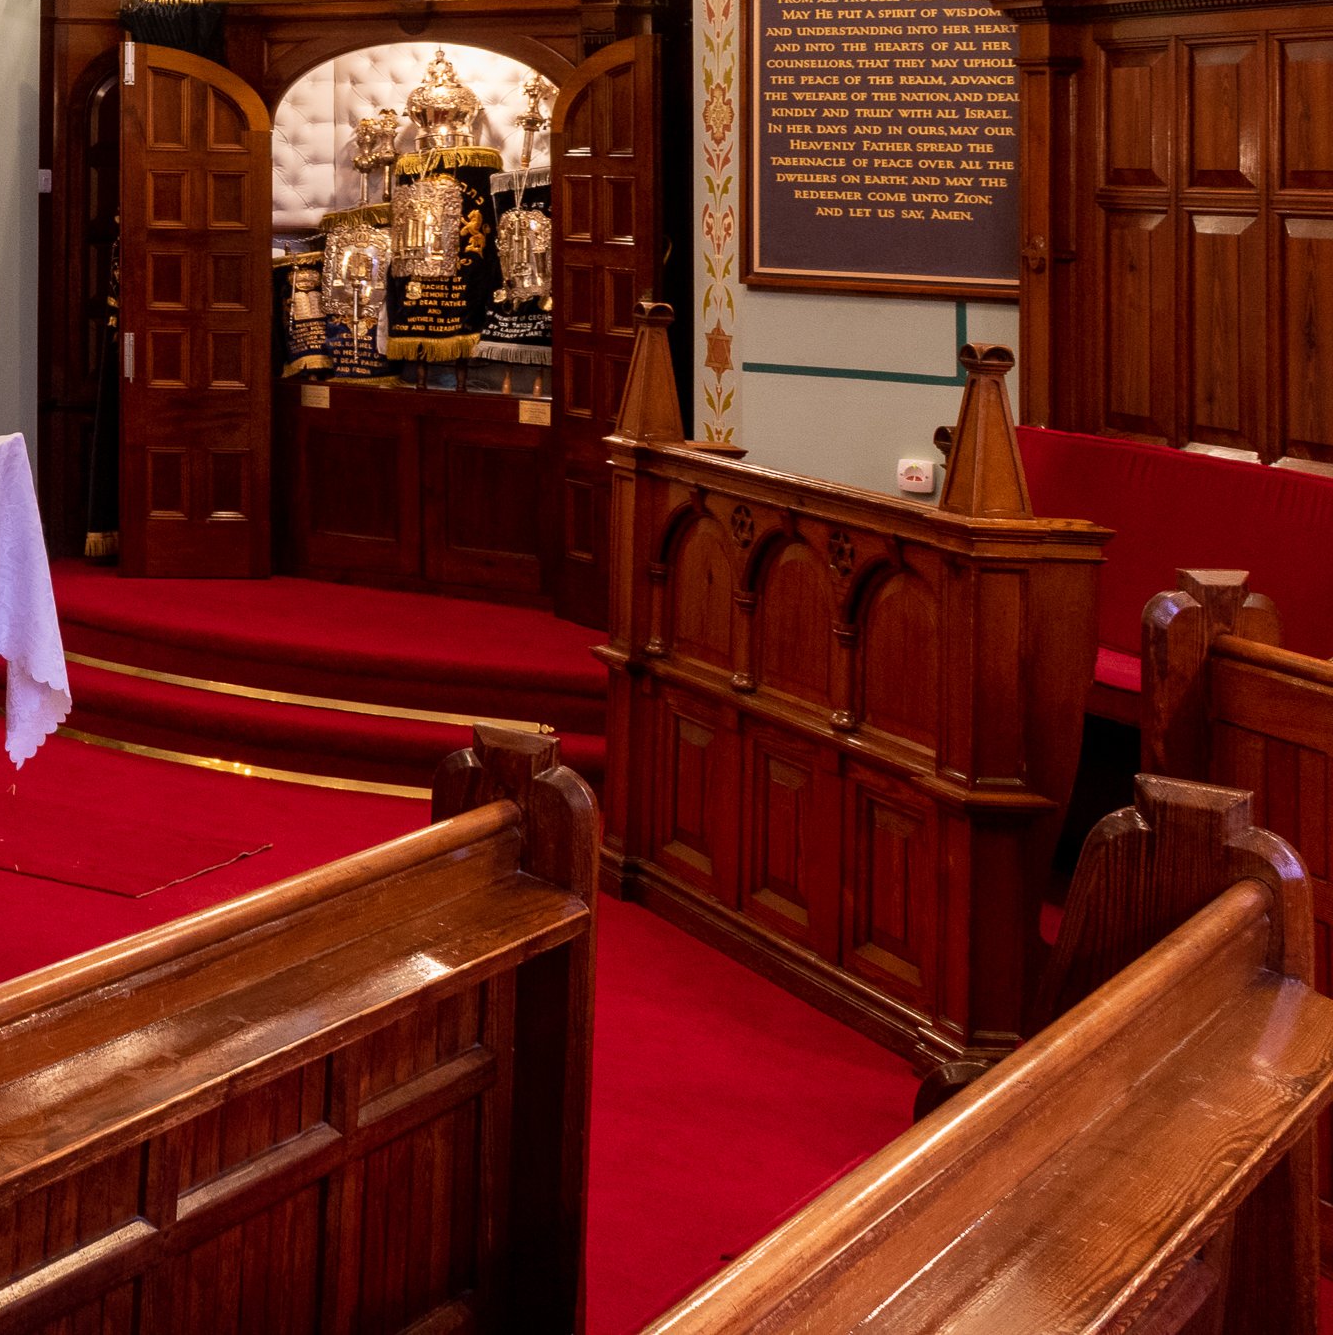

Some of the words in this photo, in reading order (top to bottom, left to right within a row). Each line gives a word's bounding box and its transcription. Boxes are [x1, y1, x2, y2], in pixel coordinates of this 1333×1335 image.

[781, 9, 811, 20] MAY
[815, 9, 834, 19] HE
[837, 10, 863, 19] PUT
[865, 9, 875, 19] A
[878, 8, 917, 18] SPIRIT
[920, 8, 938, 18] OF
[942, 7, 1002, 17] WISDOM
[815, 206, 843, 217] AND
[848, 208, 872, 217] LET
[877, 209, 895, 218] US
